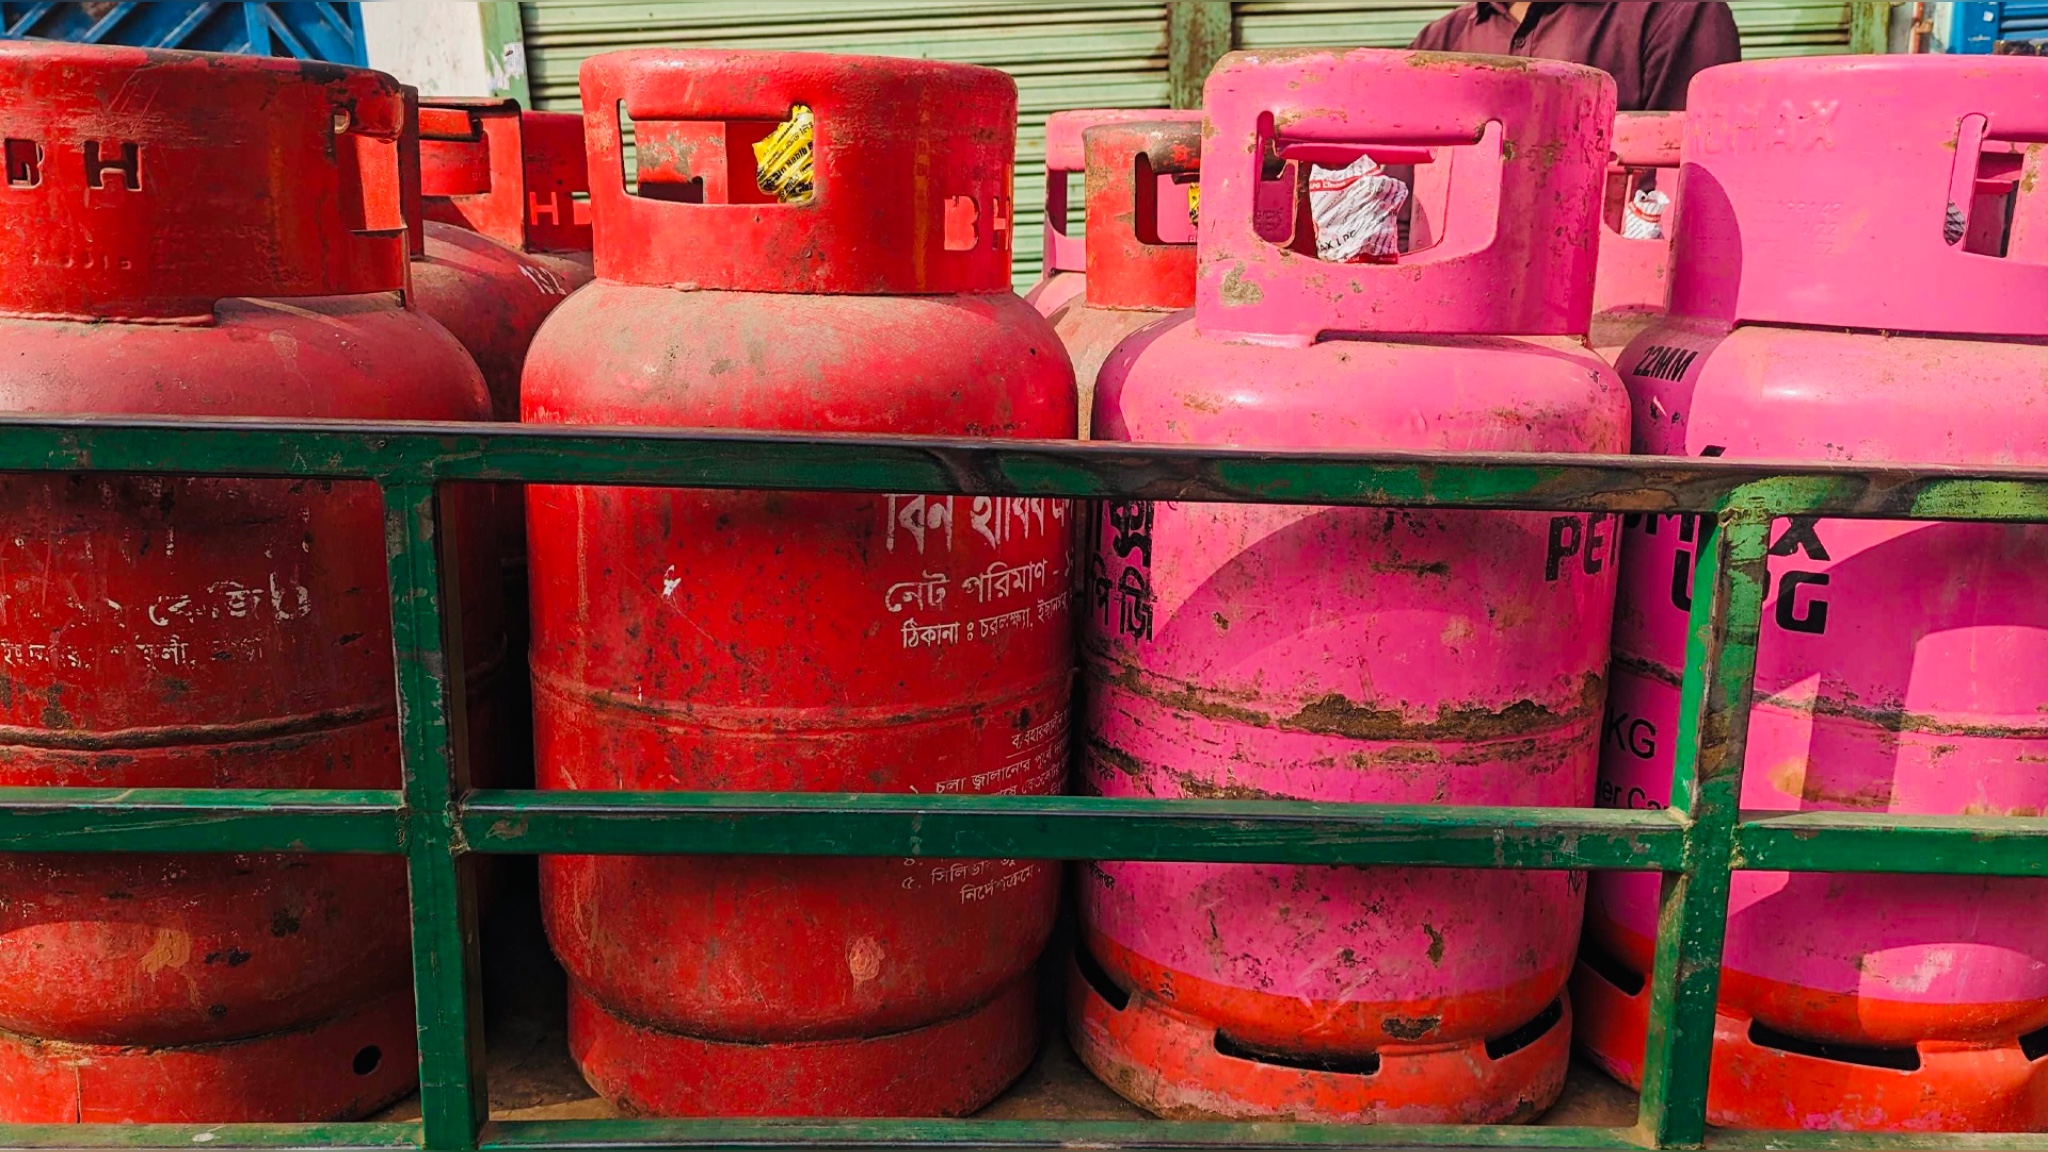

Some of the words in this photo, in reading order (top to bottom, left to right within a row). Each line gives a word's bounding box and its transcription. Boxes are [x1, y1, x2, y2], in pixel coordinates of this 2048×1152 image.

[1633, 345, 1699, 384] 22MM
[885, 568, 950, 613] নেট
[961, 557, 1048, 604] পরিমাণ
[1671, 549, 1830, 635] LG
[901, 617, 961, 649] ঠিকানা
[971, 758, 1031, 791] জ্বালানোর
